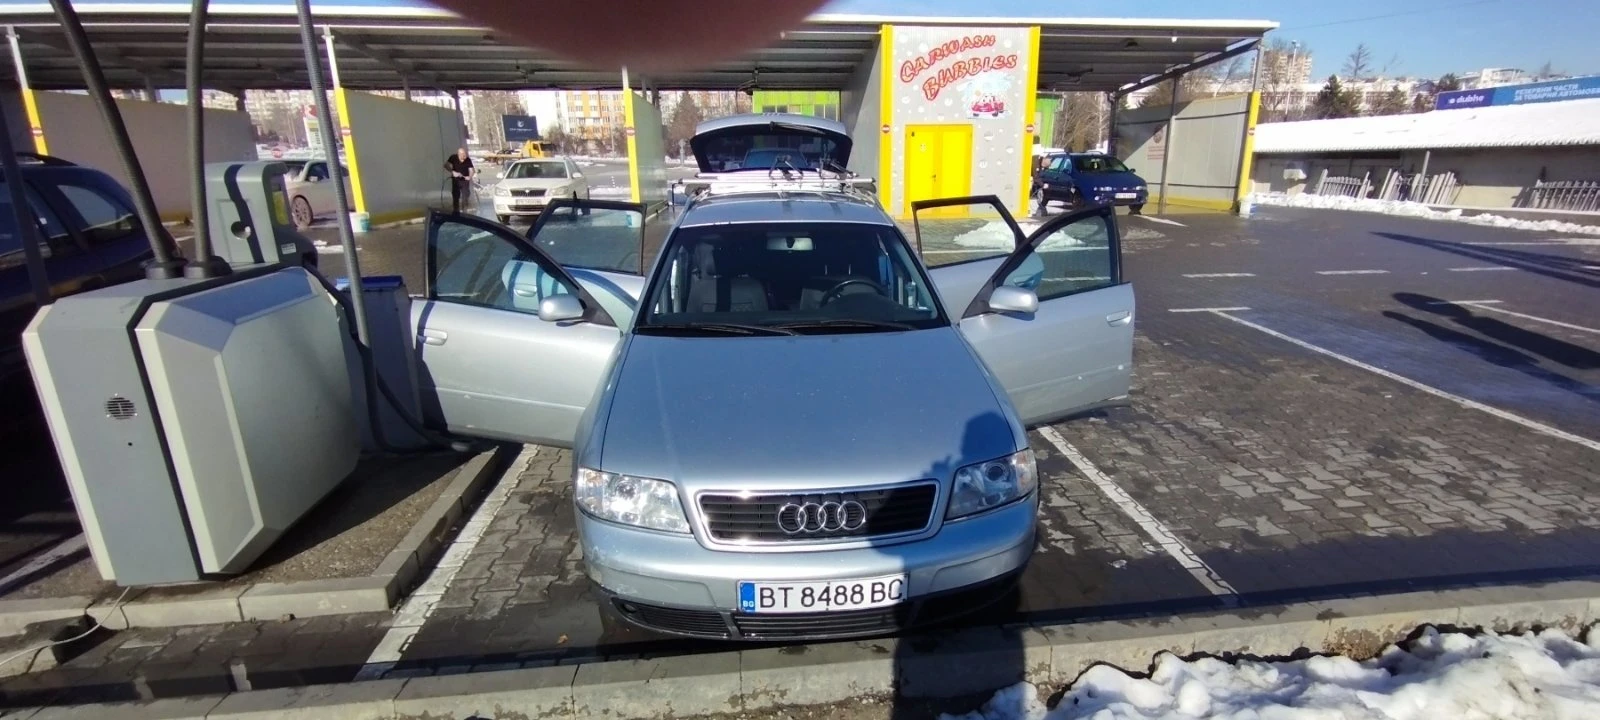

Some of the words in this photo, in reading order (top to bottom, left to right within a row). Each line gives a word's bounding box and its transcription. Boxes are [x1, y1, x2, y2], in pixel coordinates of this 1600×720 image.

[901, 35, 996, 83] CARWASH
[923, 55, 1018, 101] BUBBLES
[742, 600, 755, 608] BG
[759, 587, 794, 608] BT
[801, 584, 864, 608] 8488
[871, 579, 904, 603] BC
